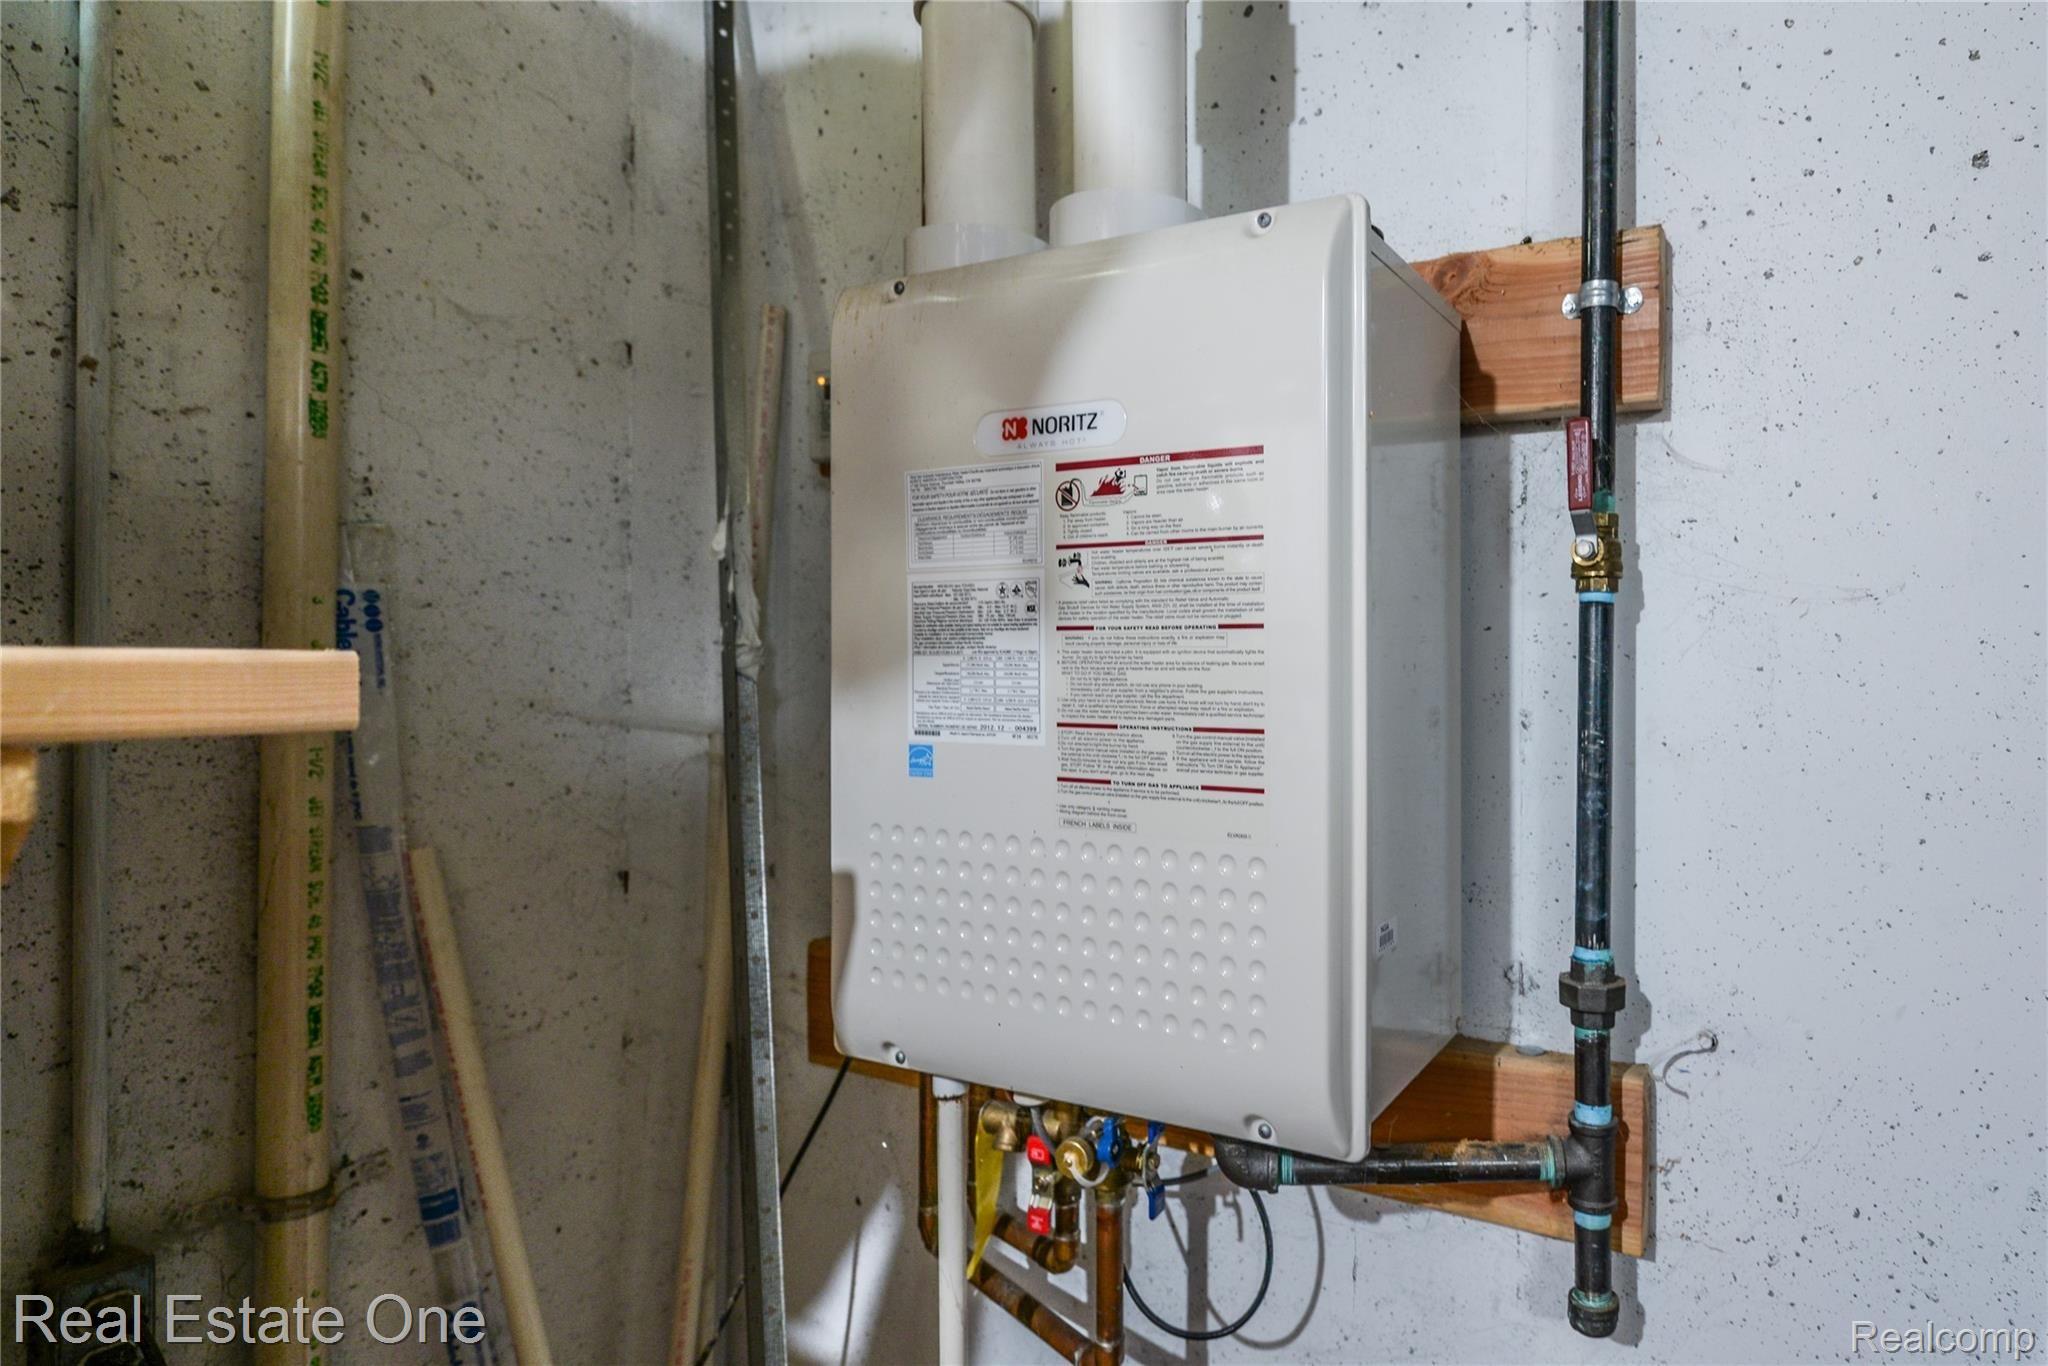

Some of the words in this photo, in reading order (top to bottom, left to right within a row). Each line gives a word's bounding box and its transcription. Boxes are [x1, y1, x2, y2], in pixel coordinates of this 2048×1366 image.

[1032, 412, 1098, 435] NORITZ
[1018, 440, 1056, 449] ALWAYS
[1139, 454, 1171, 463] DANGER
[336, 589, 358, 650] Cable
[1063, 819, 1086, 827] FRENCH
[1088, 821, 1110, 829] LABELS
[1113, 823, 1132, 831] INSIDE
